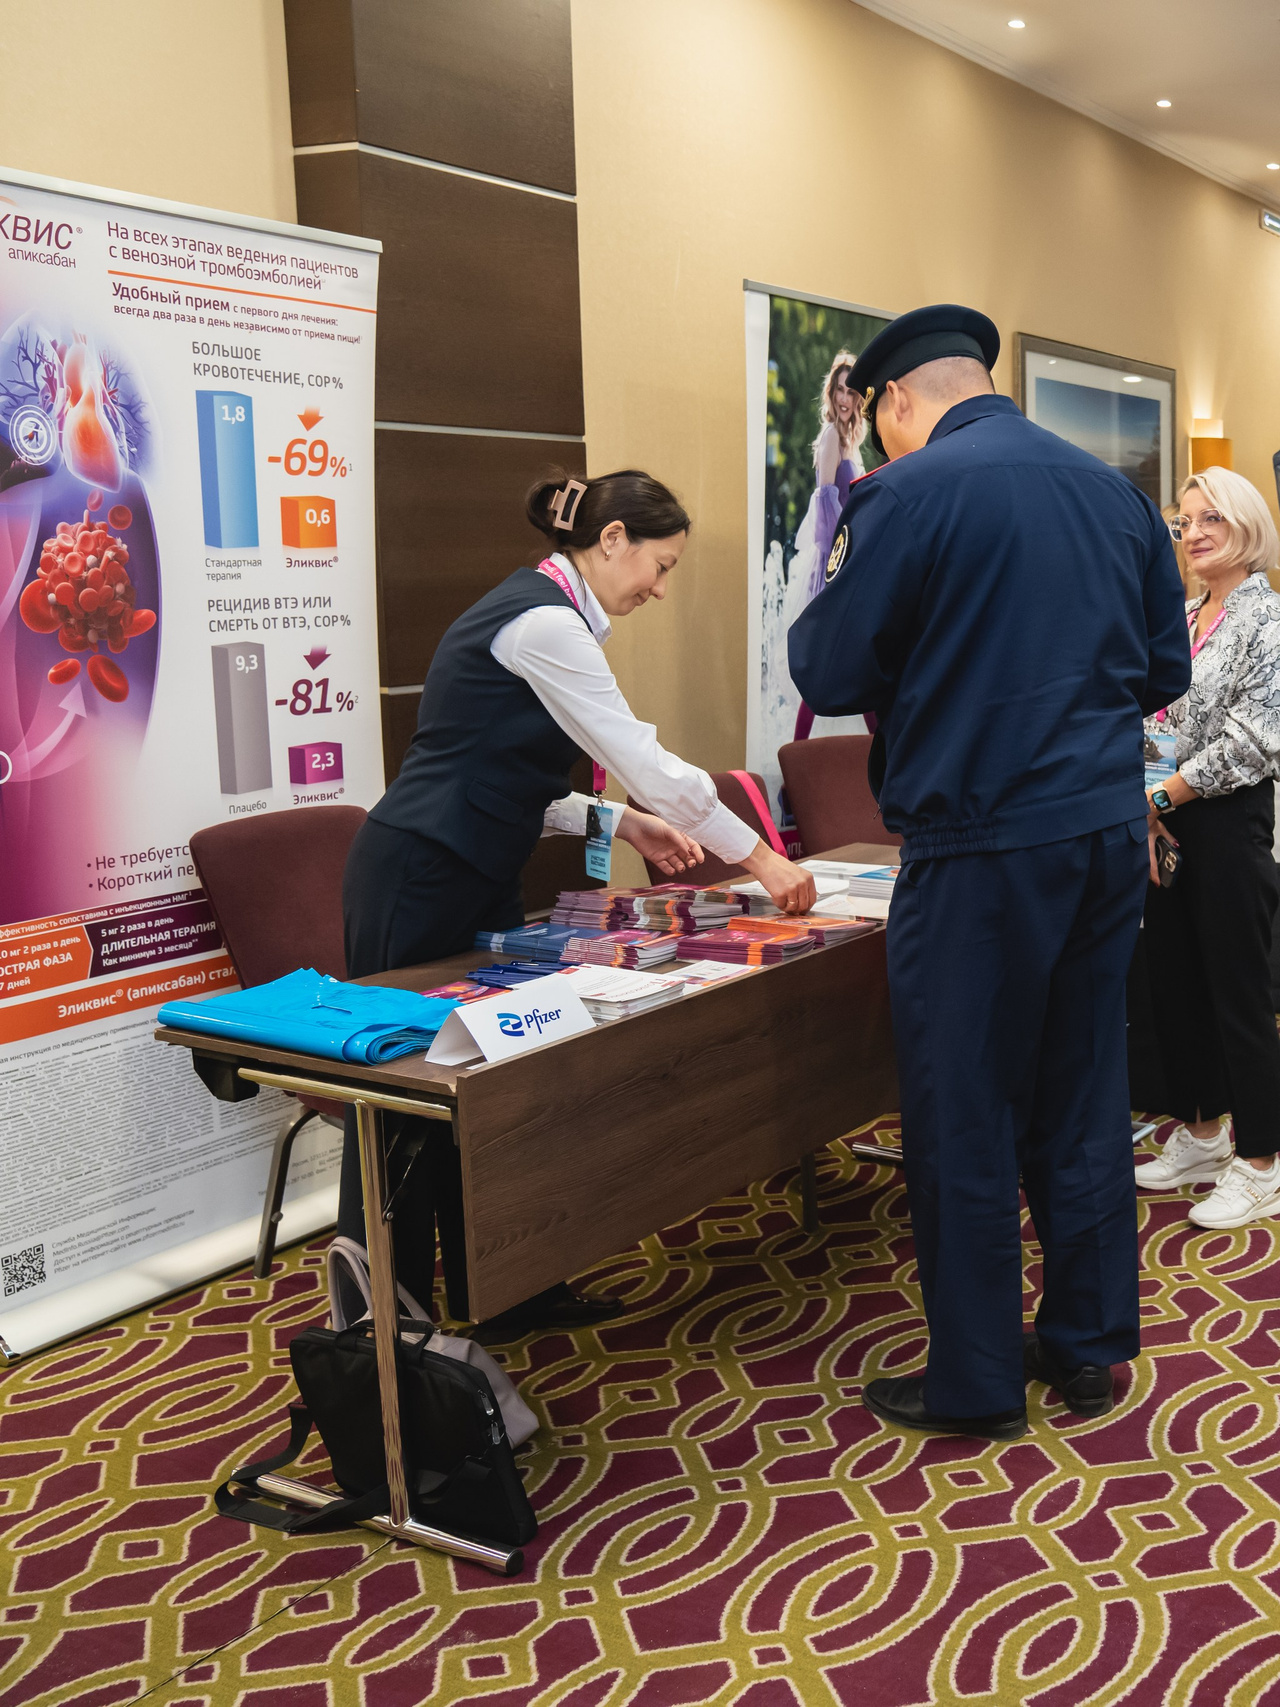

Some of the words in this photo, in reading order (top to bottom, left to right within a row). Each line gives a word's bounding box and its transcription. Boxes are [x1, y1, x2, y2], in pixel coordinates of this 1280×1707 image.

[8, 247, 77, 269] апиксабан
[107, 221, 129, 240] На
[133, 227, 168, 248] всех
[172, 234, 223, 256] этапах
[227, 244, 286, 267] ведения
[291, 256, 359, 279] пациентов
[108, 245, 118, 258] с
[122, 246, 196, 271] венозной
[112, 282, 181, 305] Удобный
[185, 296, 230, 312] прием
[233, 304, 239, 313] с
[240, 305, 279, 320] первого
[282, 310, 299, 321] дня
[113, 304, 150, 318] всегда
[152, 309, 172, 321] два
[174, 312, 196, 324] раза
[199, 316, 205, 325] в
[207, 317, 231, 329] день
[233, 320, 290, 336] независимо
[292, 327, 302, 337] от
[304, 329, 335, 342] приема
[192, 341, 262, 362] БОЛЬШОЕ
[192, 362, 304, 388] КРОВОТЕЧЕНИЕ,
[221, 404, 246, 423] 1,8
[305, 508, 331, 527] 0,6
[205, 557, 262, 569] Стандартная
[206, 572, 242, 582] терапия
[208, 597, 270, 613] РЕЦИДИВ
[274, 597, 299, 609] ВТЭ
[303, 596, 332, 608] ИЛИ
[208, 618, 259, 632] СМЕРТЬ
[262, 617, 279, 630] ОТ
[282, 616, 311, 630] ВТЭ,
[235, 654, 258, 674] 9,3
[311, 752, 335, 770] 2,3
[228, 800, 267, 815] Плацебо
[95, 856, 116, 870] Не
[97, 866, 173, 891] Короткий
[59, 910, 108, 926] сопоставима
[109, 908, 114, 916] с
[115, 898, 171, 914] инъекционным
[101, 929, 107, 937] 5
[108, 927, 118, 936] мг
[120, 925, 125, 933] 2
[126, 921, 146, 934] раза
[147, 920, 153, 928] в
[154, 916, 174, 926] день
[9, 948, 21, 957] мг
[23, 946, 29, 954] 2
[31, 942, 51, 954] раза
[53, 940, 58, 948] в
[60, 936, 81, 946] день
[101, 931, 171, 956] ДЛИТЕЛЬНАЯ
[172, 921, 216, 939] ТЕРАПИЯ
[43, 951, 73, 967] ФАЗА
[102, 957, 119, 967] Как
[119, 949, 156, 963] минимум
[7, 976, 31, 990] дней
[127, 972, 206, 1002] (апиксабан)
[524, 1008, 562, 1034] Pfizer
[10, 1046, 52, 1061] инструкция
[62, 1031, 109, 1048] медицинскому
